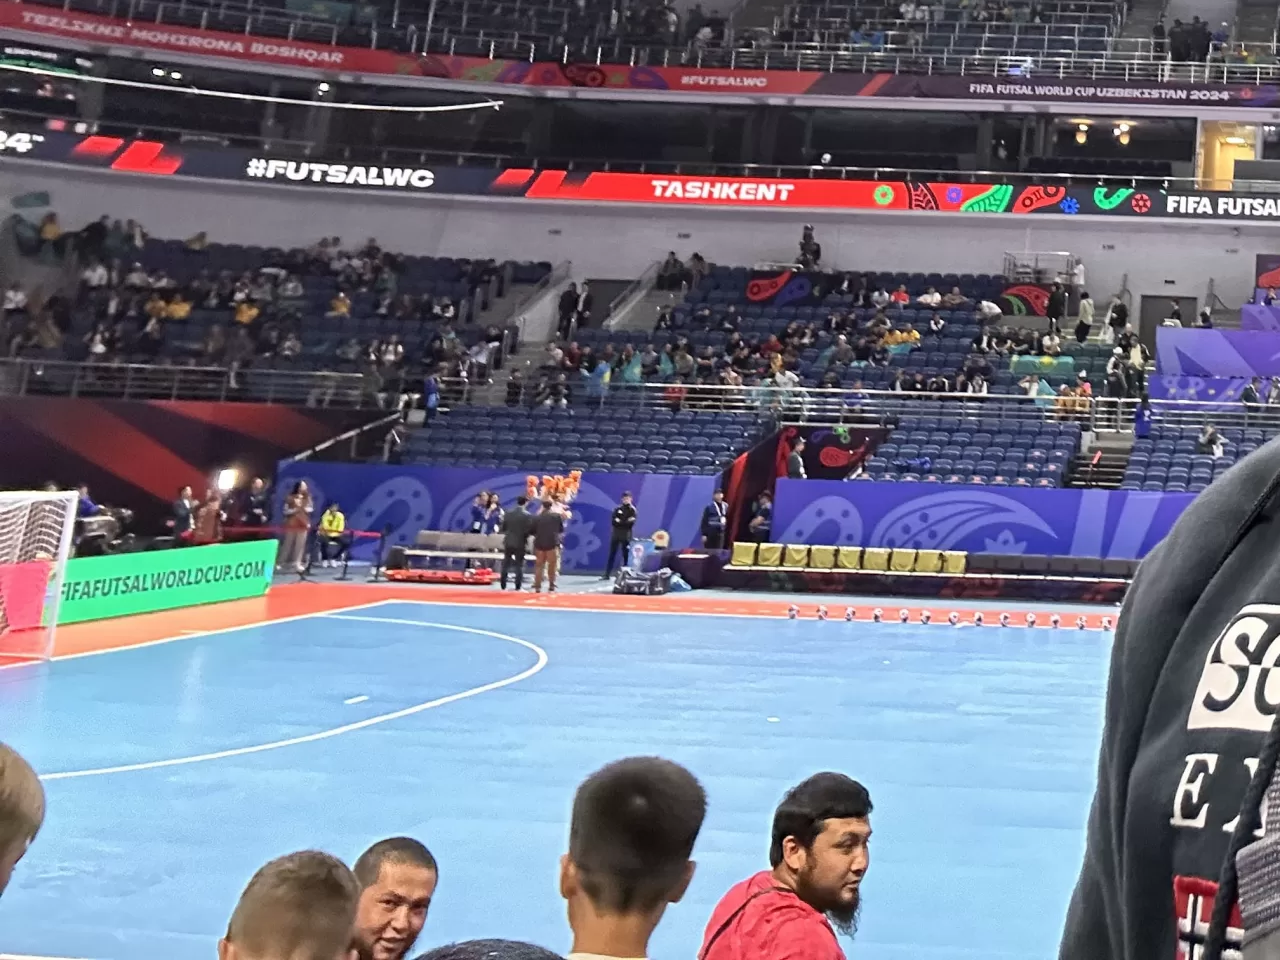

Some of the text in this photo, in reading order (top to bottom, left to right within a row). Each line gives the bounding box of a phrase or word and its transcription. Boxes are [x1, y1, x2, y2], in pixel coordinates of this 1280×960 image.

[130, 28, 244, 53] MOHIRONA
[250, 44, 345, 64] BOSHQAR
[681, 75, 768, 87] #FUTSALWC
[969, 83, 995, 94] FIFA
[996, 84, 1033, 96] FUTSAL
[1034, 85, 1073, 97] WORLD
[1074, 86, 1095, 98] CUP
[1096, 87, 1187, 100] UZBEKISTAN
[246, 156, 436, 188] #FUTSALWC
[651, 179, 795, 201] TASHKENT
[1166, 195, 1214, 215] FIFA
[61, 561, 266, 601] FIFAFUTSALWORLDCUP.COM
